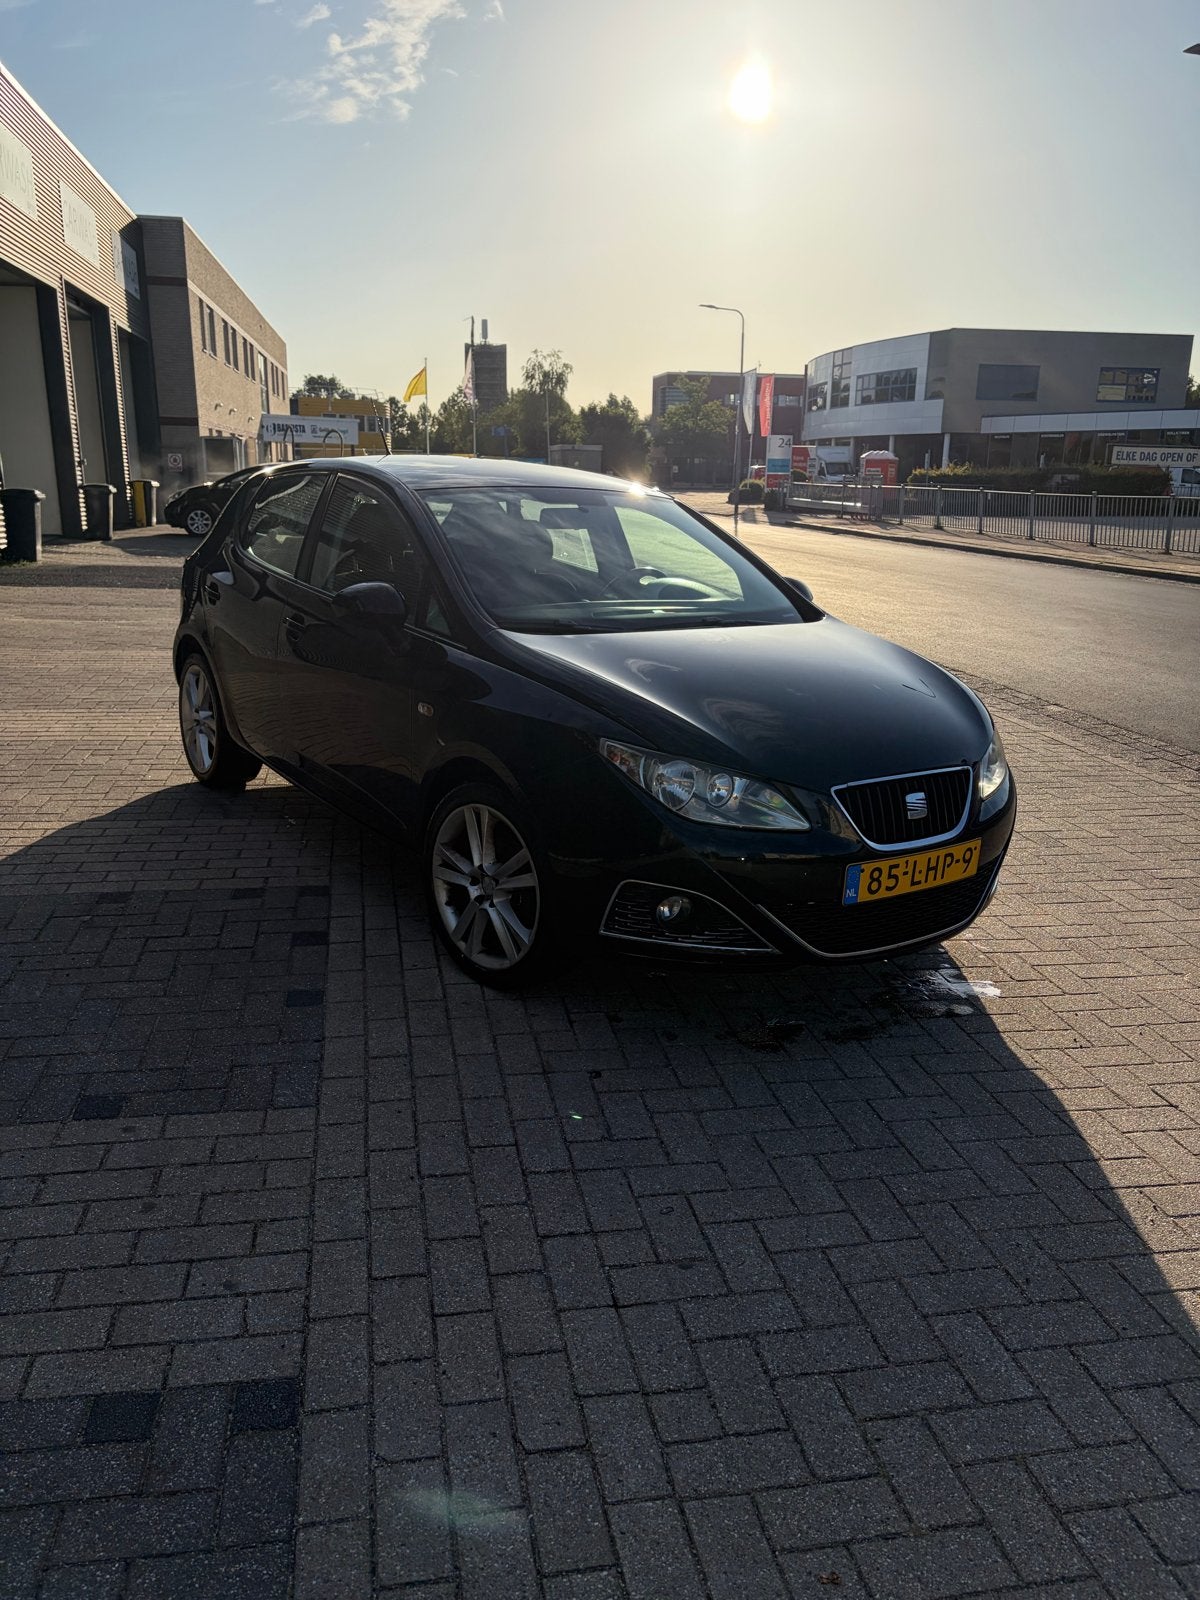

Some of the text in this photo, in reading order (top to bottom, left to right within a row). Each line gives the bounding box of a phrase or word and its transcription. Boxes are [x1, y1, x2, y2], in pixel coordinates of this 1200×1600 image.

[778, 438, 792, 449] 24
[1116, 451, 1199, 463] ELKE DAG OPEN OF
[867, 846, 973, 895] 85-LHP-9
[846, 889, 857, 898] NL
